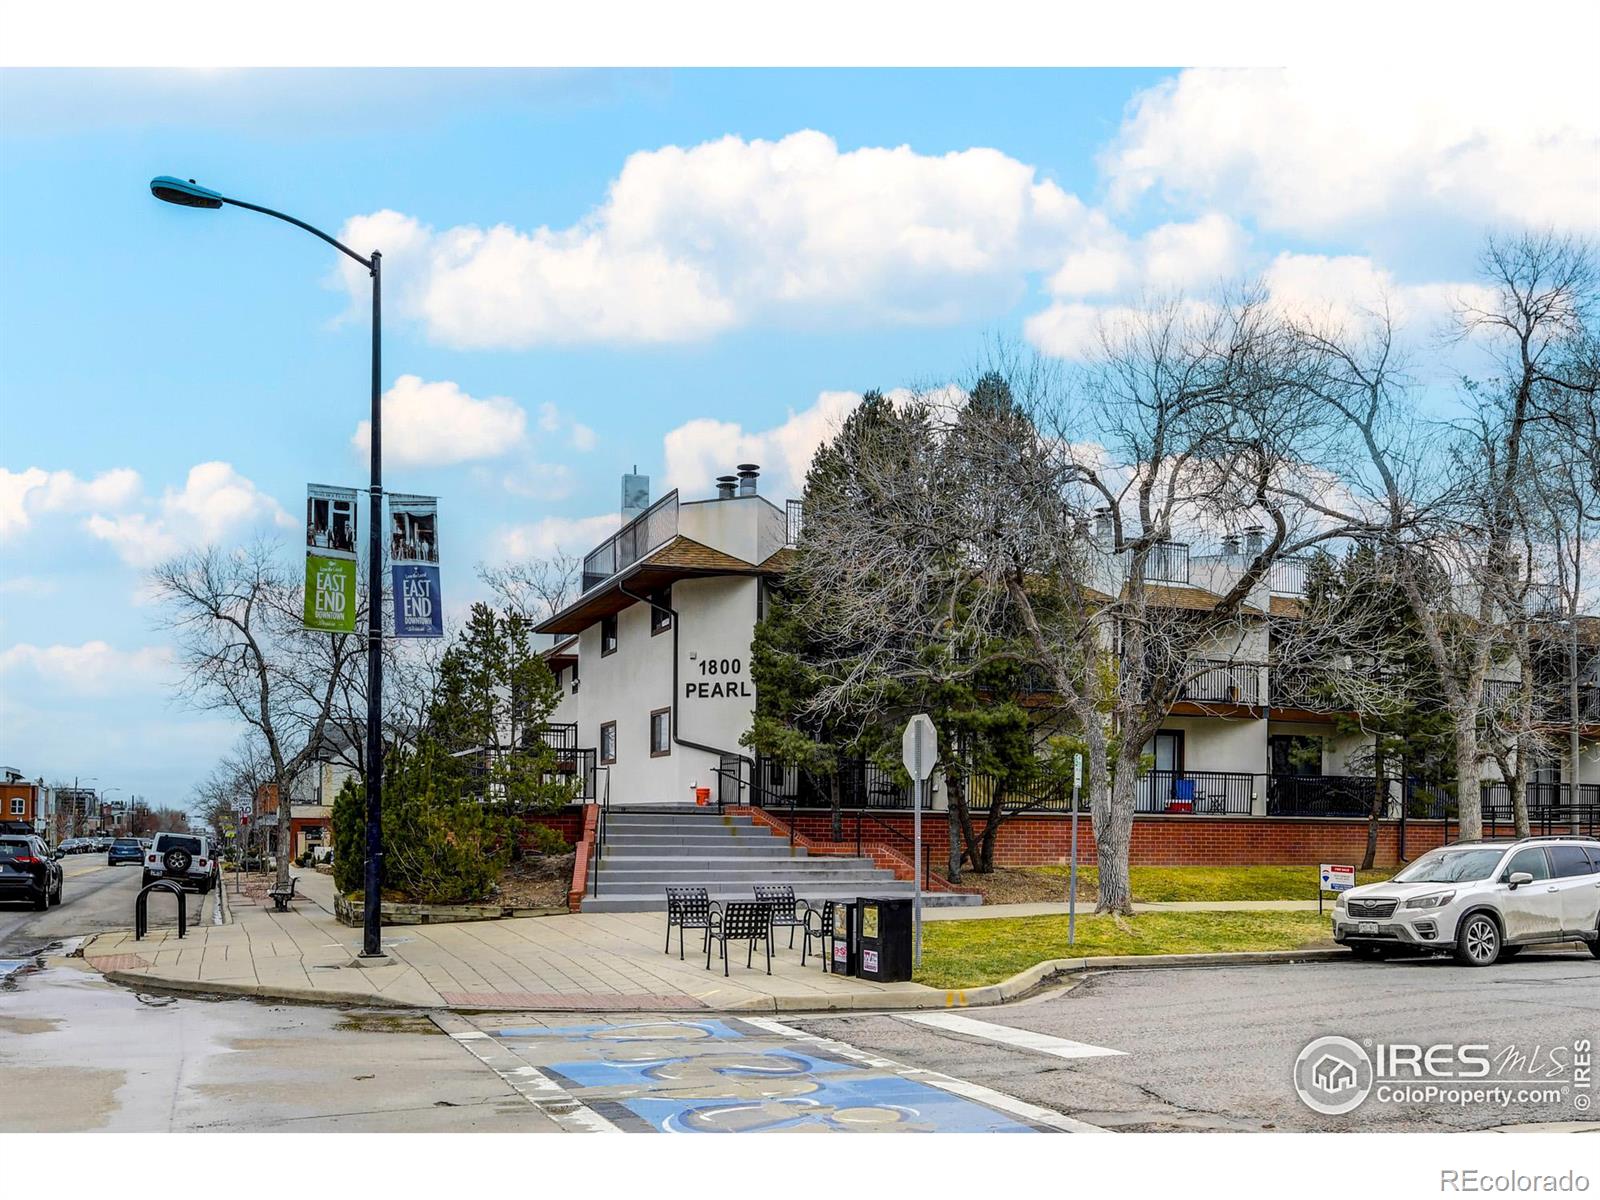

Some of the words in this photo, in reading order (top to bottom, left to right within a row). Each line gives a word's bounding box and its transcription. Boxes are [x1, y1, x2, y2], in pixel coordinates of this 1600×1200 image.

[317, 573, 346, 592] EAST
[403, 580, 431, 597] EAST
[316, 591, 345, 612] END
[403, 597, 432, 617] END
[315, 611, 345, 620] DOWNTOWN
[405, 617, 432, 625] DOWNTOWN
[699, 658, 741, 676] 1800
[685, 681, 751, 698] PEARL
